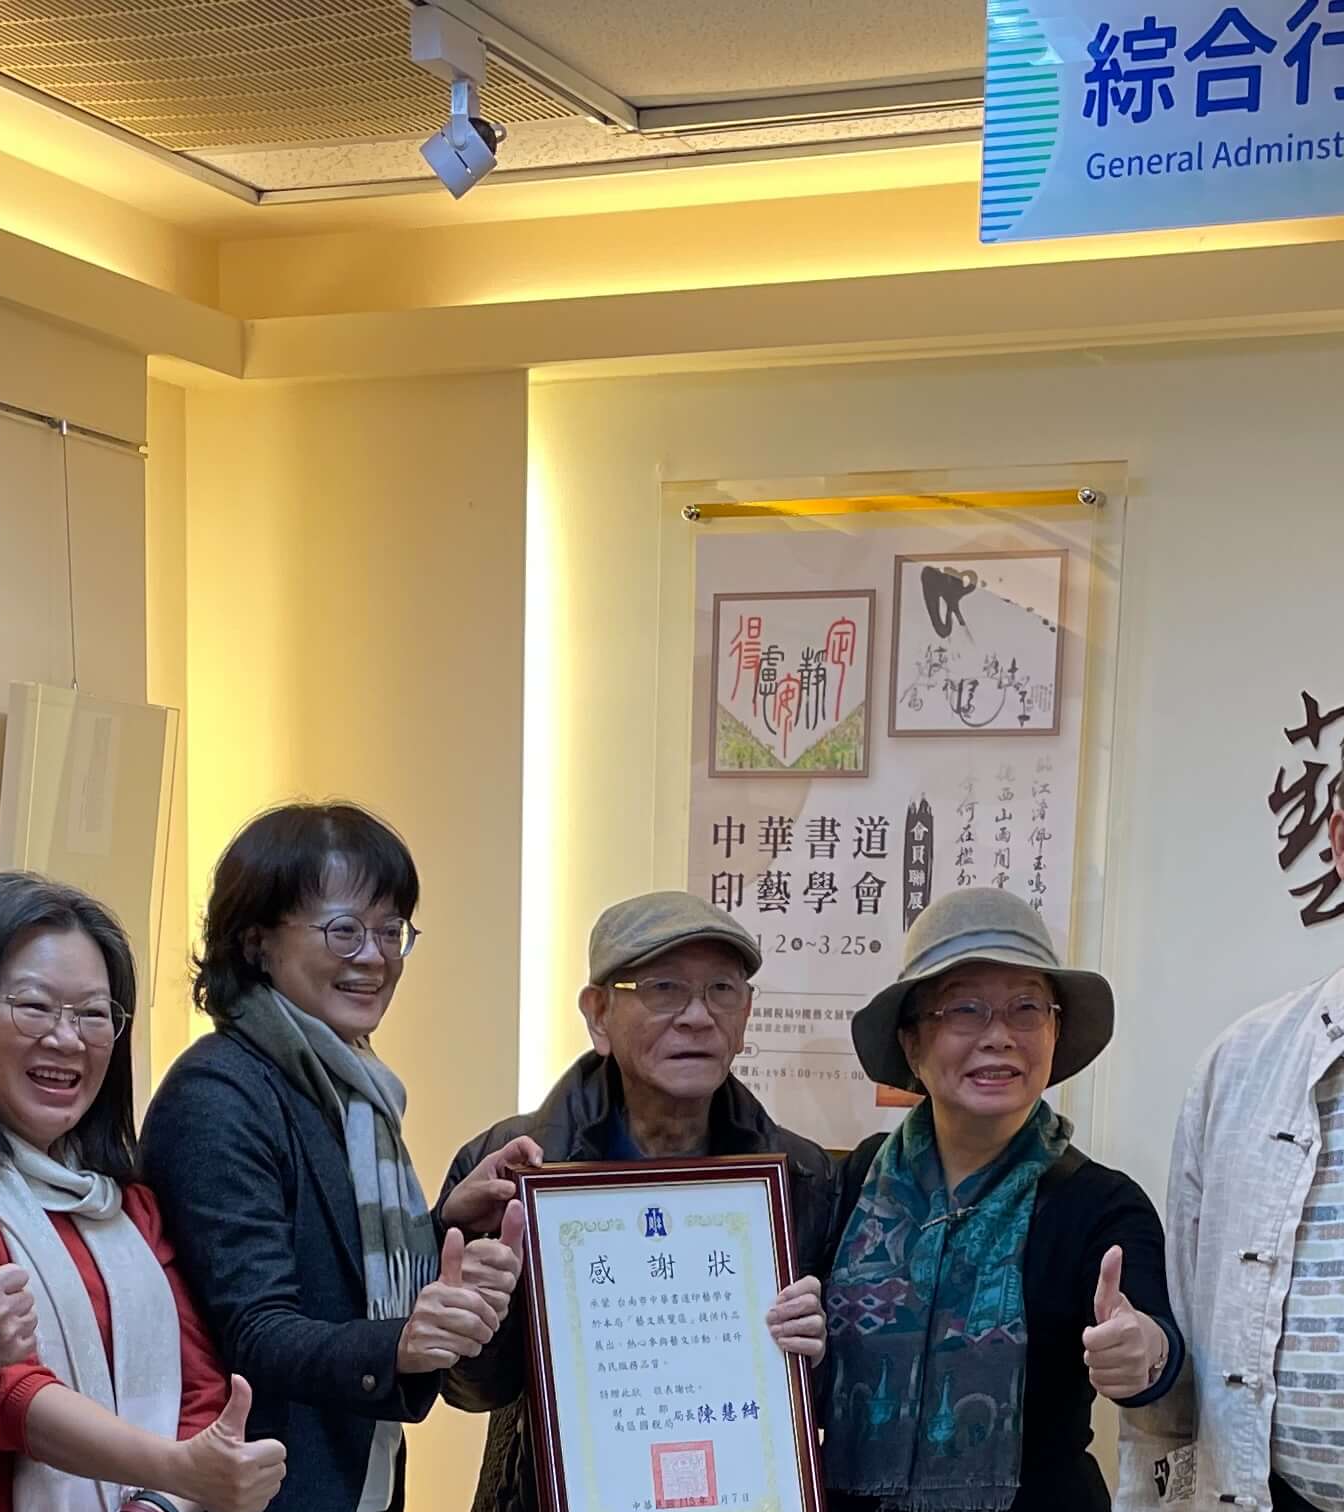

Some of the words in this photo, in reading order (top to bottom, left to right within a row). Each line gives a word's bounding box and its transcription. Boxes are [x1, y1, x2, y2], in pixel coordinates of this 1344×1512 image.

[1086, 142, 1204, 180] General
[712, 816, 890, 859] 中華書道
[907, 821, 929, 910] 會員聯展
[711, 870, 887, 914] 印藝學會
[589, 1250, 736, 1285] 感謝狀
